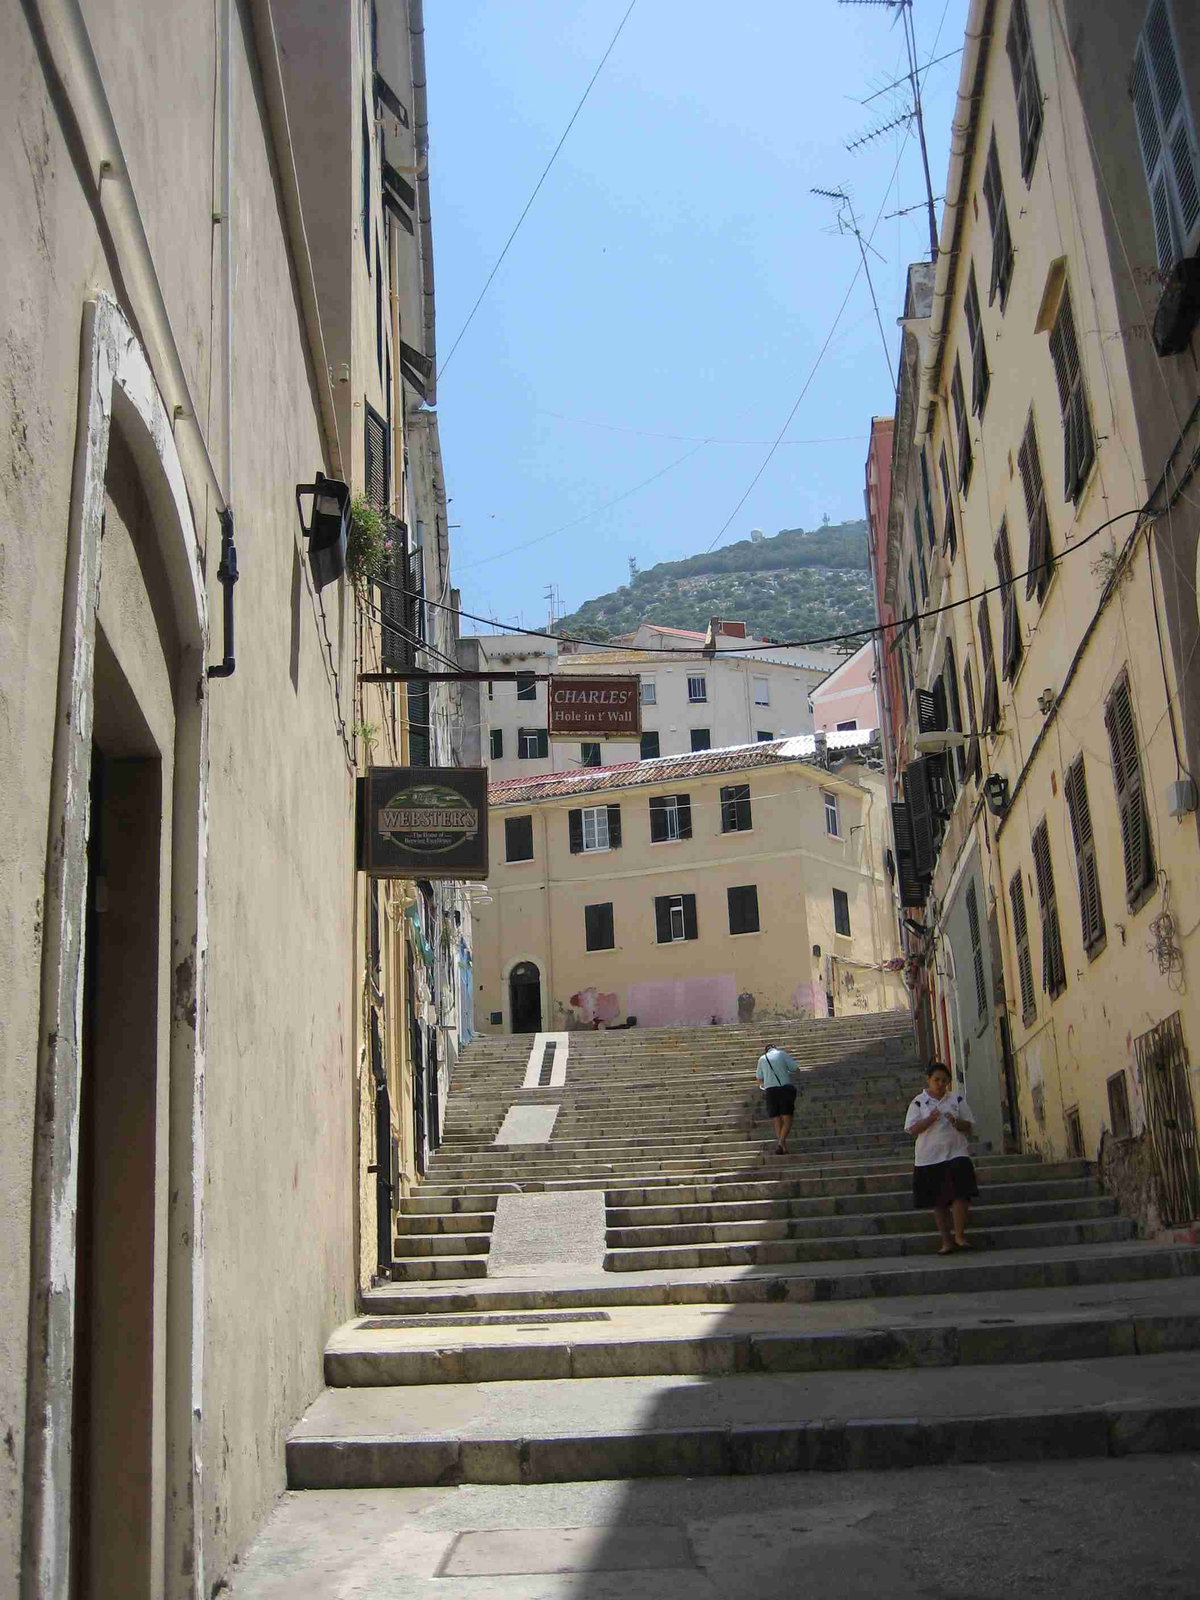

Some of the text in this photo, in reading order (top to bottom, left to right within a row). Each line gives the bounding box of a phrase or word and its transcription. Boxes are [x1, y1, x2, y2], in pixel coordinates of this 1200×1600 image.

[554, 690, 632, 704] CHARLES'
[554, 710, 581, 721] Hole
[584, 711, 595, 721] in
[607, 711, 632, 721] Wall
[382, 810, 477, 828] WEBSTER'S
